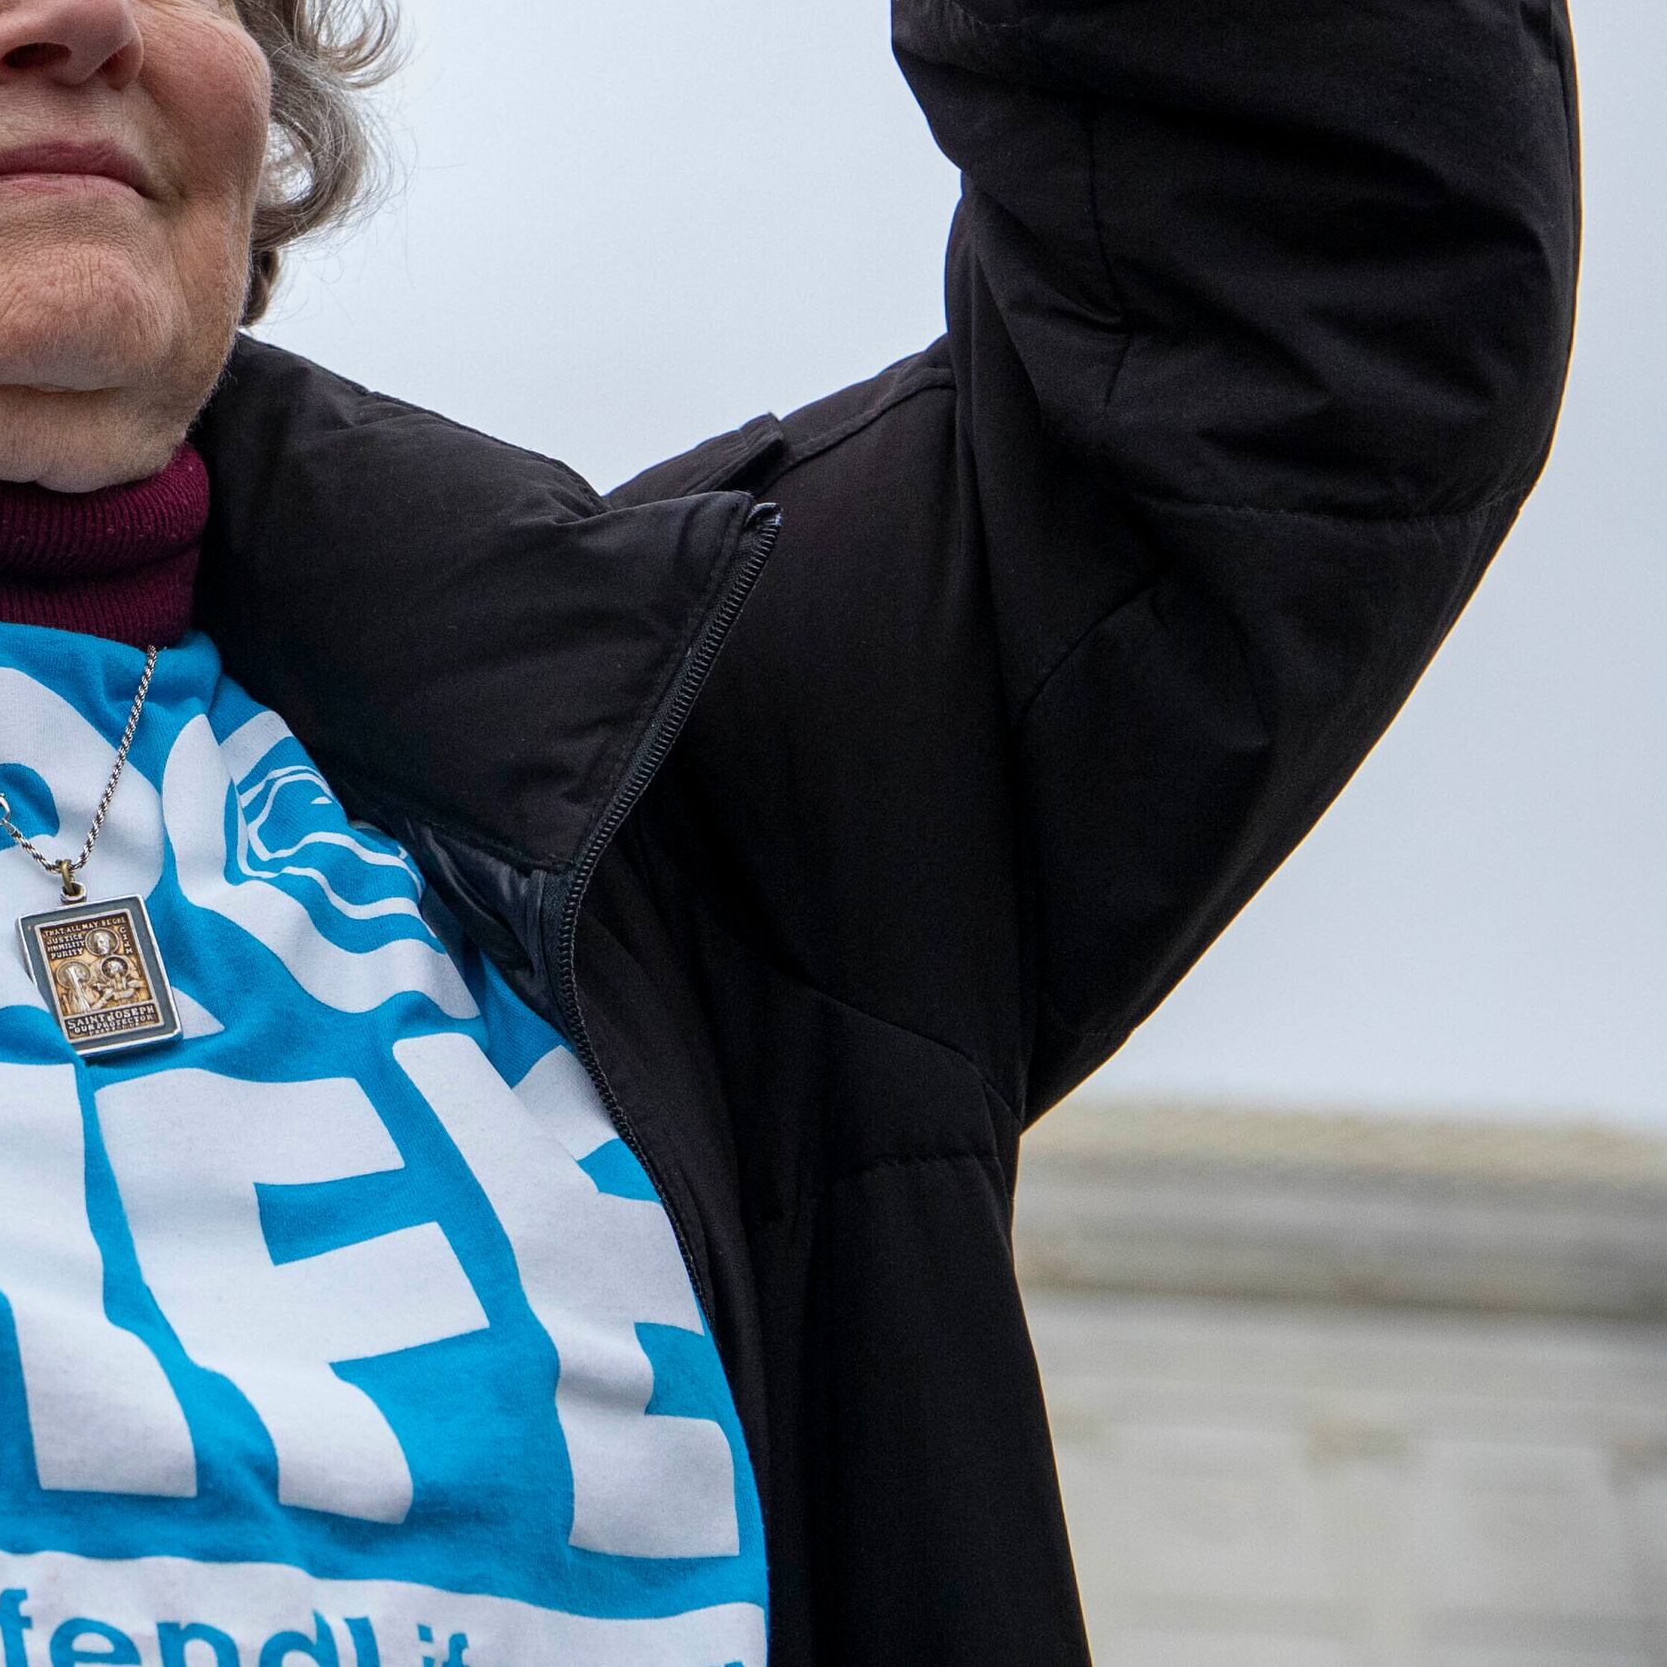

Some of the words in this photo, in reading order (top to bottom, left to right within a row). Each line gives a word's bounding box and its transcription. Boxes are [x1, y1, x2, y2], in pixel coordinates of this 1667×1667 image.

[45, 927, 64, 936] THAT
[67, 924, 81, 933] ALL
[82, 921, 98, 929] MAY
[47, 933, 83, 945] JUSTICE
[47, 940, 85, 952] HUMILITY
[51, 948, 83, 959] PURITY
[67, 1014, 105, 1030] SAINT
[107, 1005, 154, 1021] JOSEPH
[75, 1024, 95, 1034] OUR
[96, 1014, 153, 1030] PROTECTOR
